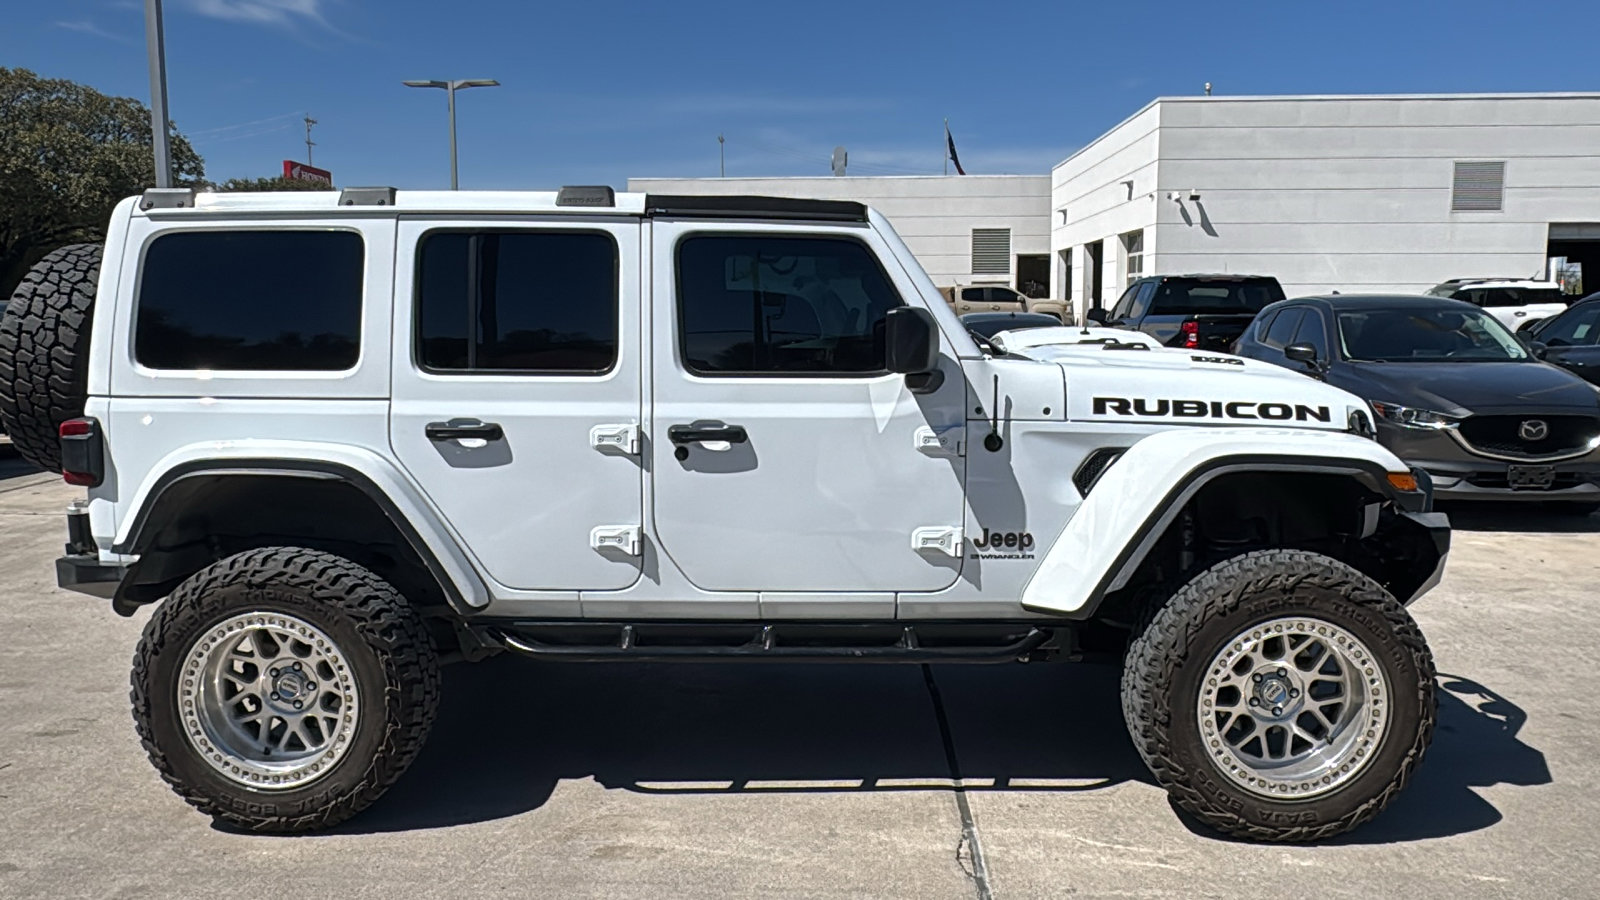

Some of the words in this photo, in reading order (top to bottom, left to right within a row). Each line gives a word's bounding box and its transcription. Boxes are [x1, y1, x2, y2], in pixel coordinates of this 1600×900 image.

[1093, 397, 1331, 422] RUBICON
[973, 528, 1033, 551] Jeep
[1258, 808, 1319, 825] BAJA
